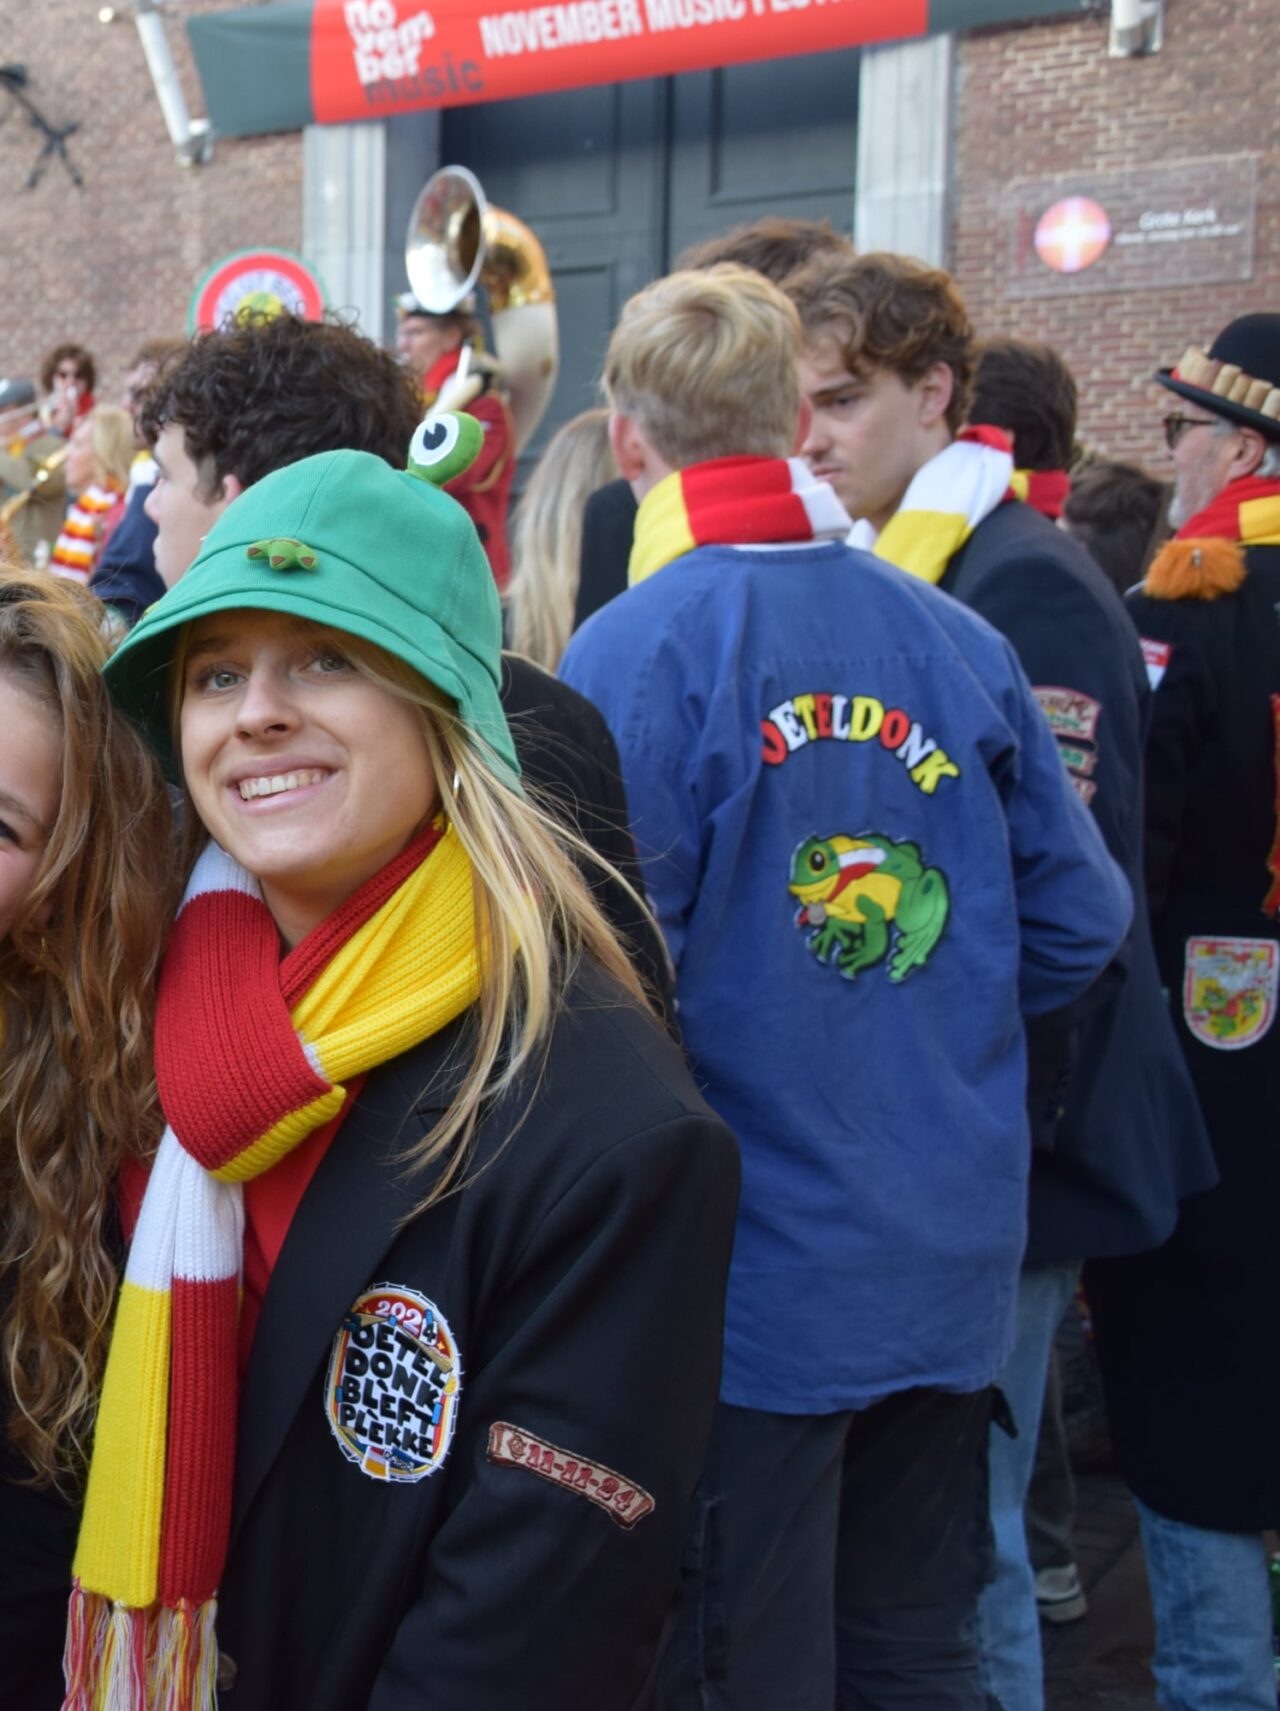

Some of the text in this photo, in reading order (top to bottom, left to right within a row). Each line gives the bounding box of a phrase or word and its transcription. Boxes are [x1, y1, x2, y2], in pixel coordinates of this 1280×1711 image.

[343, 0, 397, 33] no
[478, 0, 748, 59] NOVEMBER MUSIC
[365, 50, 485, 106] music
[760, 692, 960, 795] OETELDONK
[375, 1300, 439, 1346] 2024
[344, 1346, 440, 1413] DONK
[350, 1322, 446, 1390] OETEL
[339, 1402, 434, 1460] PLÈKKE
[340, 1374, 437, 1436] BLÈFT
[525, 1443, 637, 1512] 11-11-24
